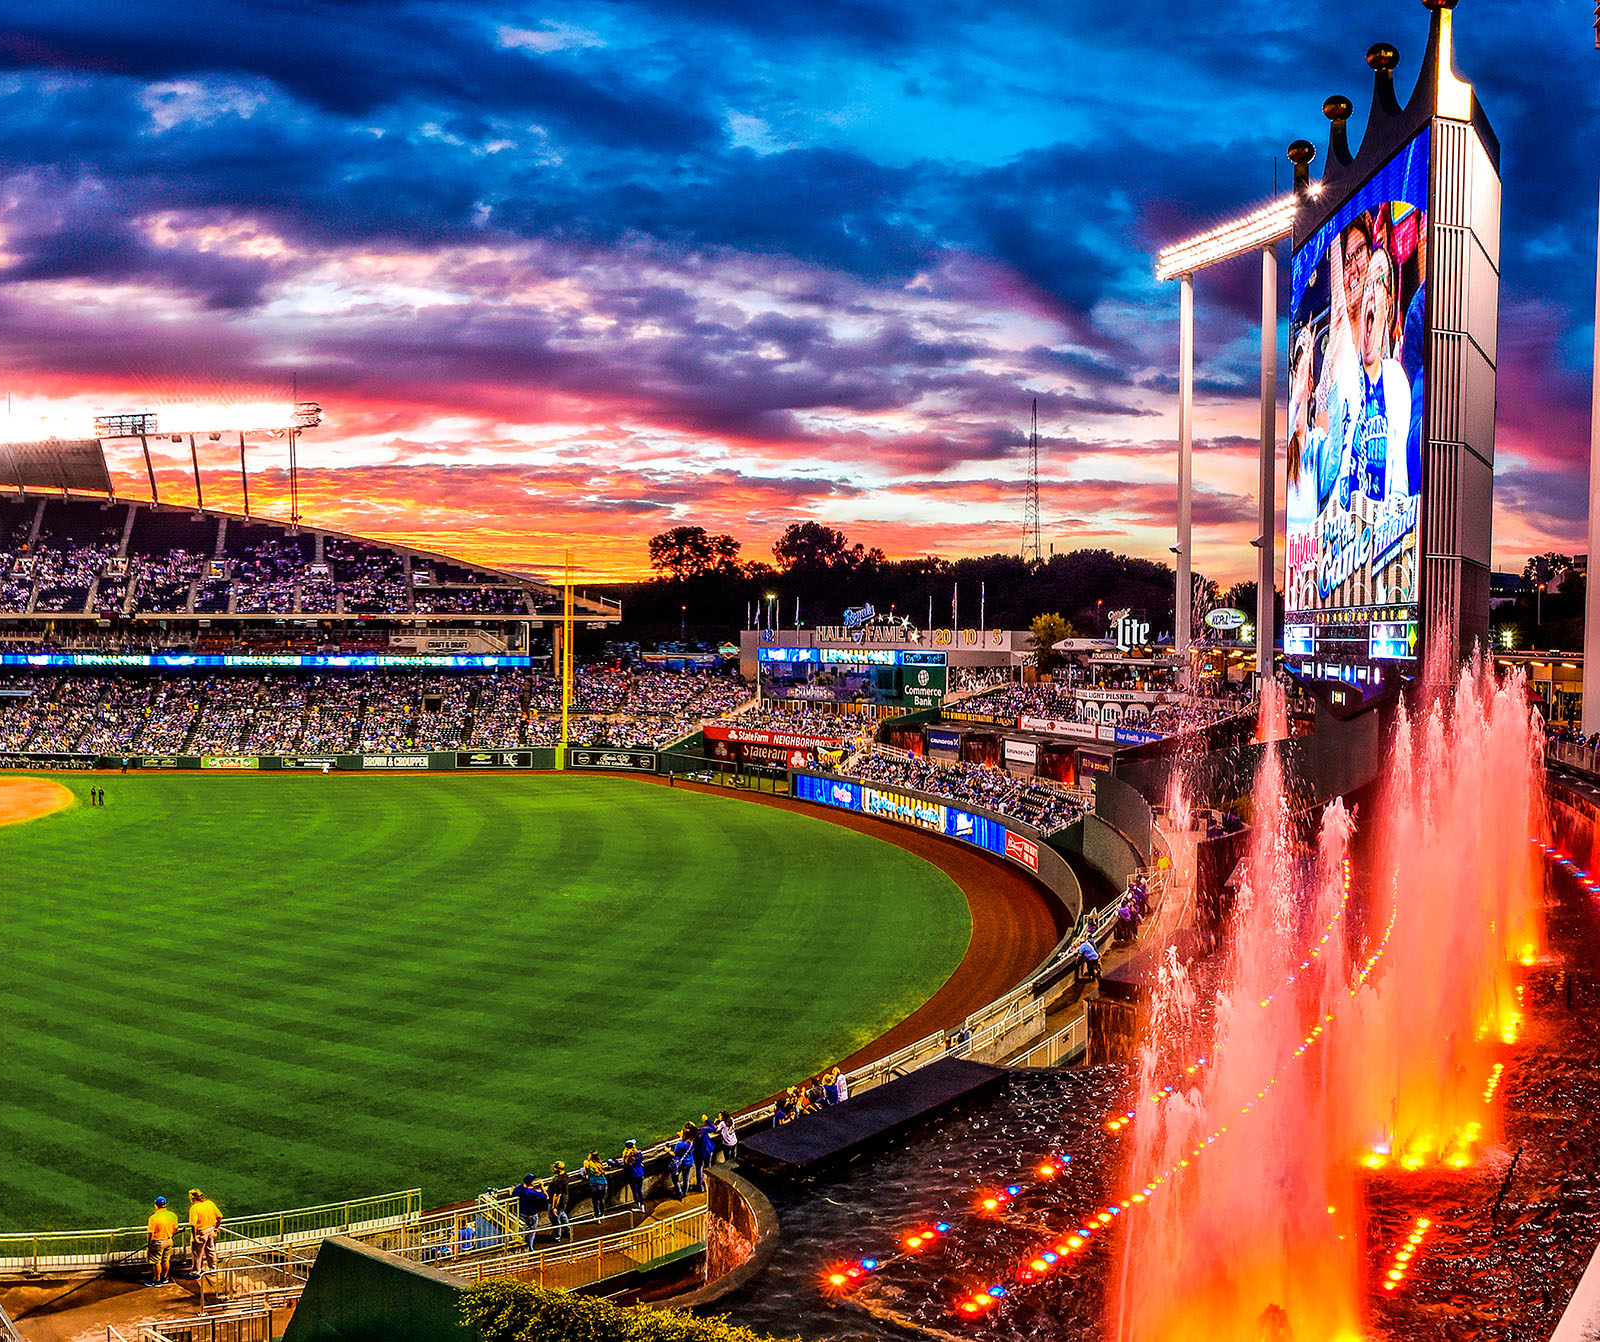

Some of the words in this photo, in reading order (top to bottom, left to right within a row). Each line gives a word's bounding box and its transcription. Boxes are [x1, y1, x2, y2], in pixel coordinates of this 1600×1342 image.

[1319, 525, 1372, 599] Game
[843, 603, 876, 628] Royals
[762, 629, 775, 642] 42
[816, 626, 851, 641] HALL
[853, 629, 865, 645] of
[866, 626, 906, 642] FAME
[935, 629, 952, 645] 20
[963, 629, 977, 645] 10
[992, 629, 1002, 645] 5
[1116, 618, 1150, 653] Lite
[904, 685, 942, 697] Commerce
[914, 695, 932, 706] Bank
[1103, 708, 1120, 722] Lite
[773, 735, 828, 748] NEIGHBORHOO
[930, 738, 953, 746] GRUNDFOS
[819, 754, 841, 765] SONIC
[1006, 748, 1030, 757] GRUNDFOS
[363, 756, 387, 767] BROWN
[387, 756, 394, 766] &
[394, 756, 428, 767] CROUPPEN
[502, 753, 518, 767] KC
